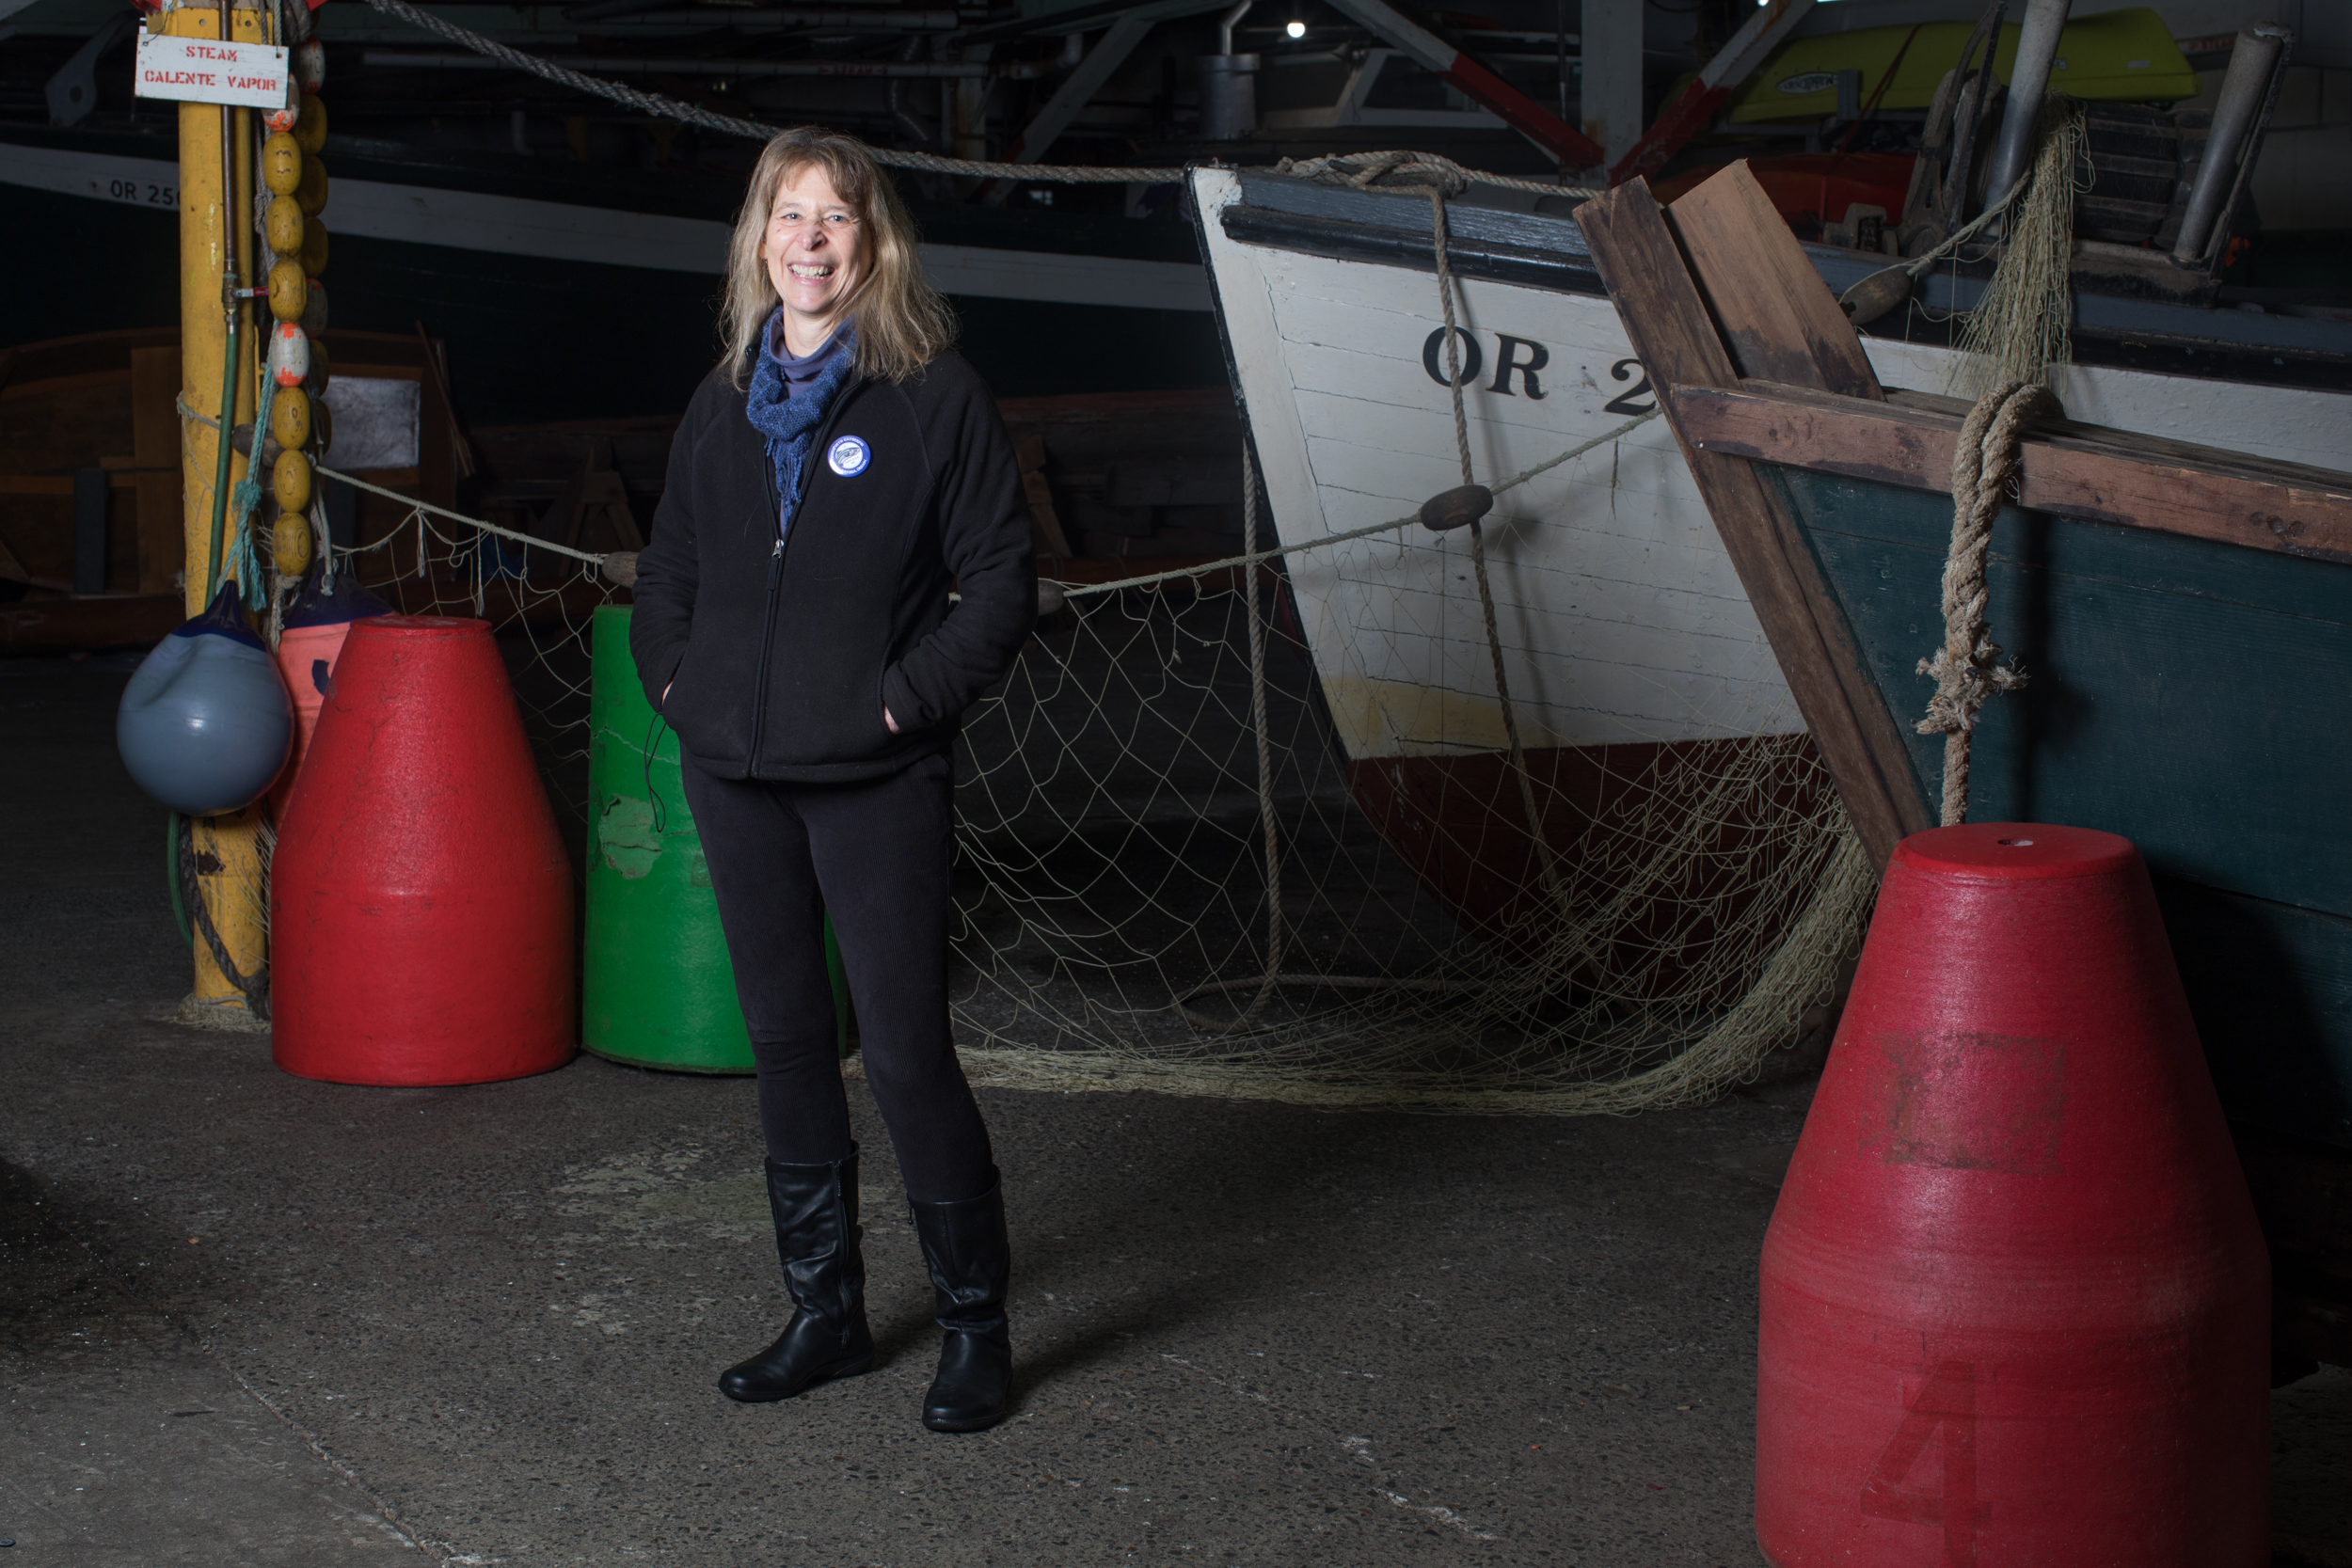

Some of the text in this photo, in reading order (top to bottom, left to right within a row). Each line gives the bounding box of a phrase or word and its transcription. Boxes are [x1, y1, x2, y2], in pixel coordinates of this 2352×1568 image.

[185, 45, 237, 62] STEAM
[145, 70, 277, 91] CALENTE VAPOR
[110, 180, 180, 205] OR 25
[1422, 325, 1549, 401] OR
